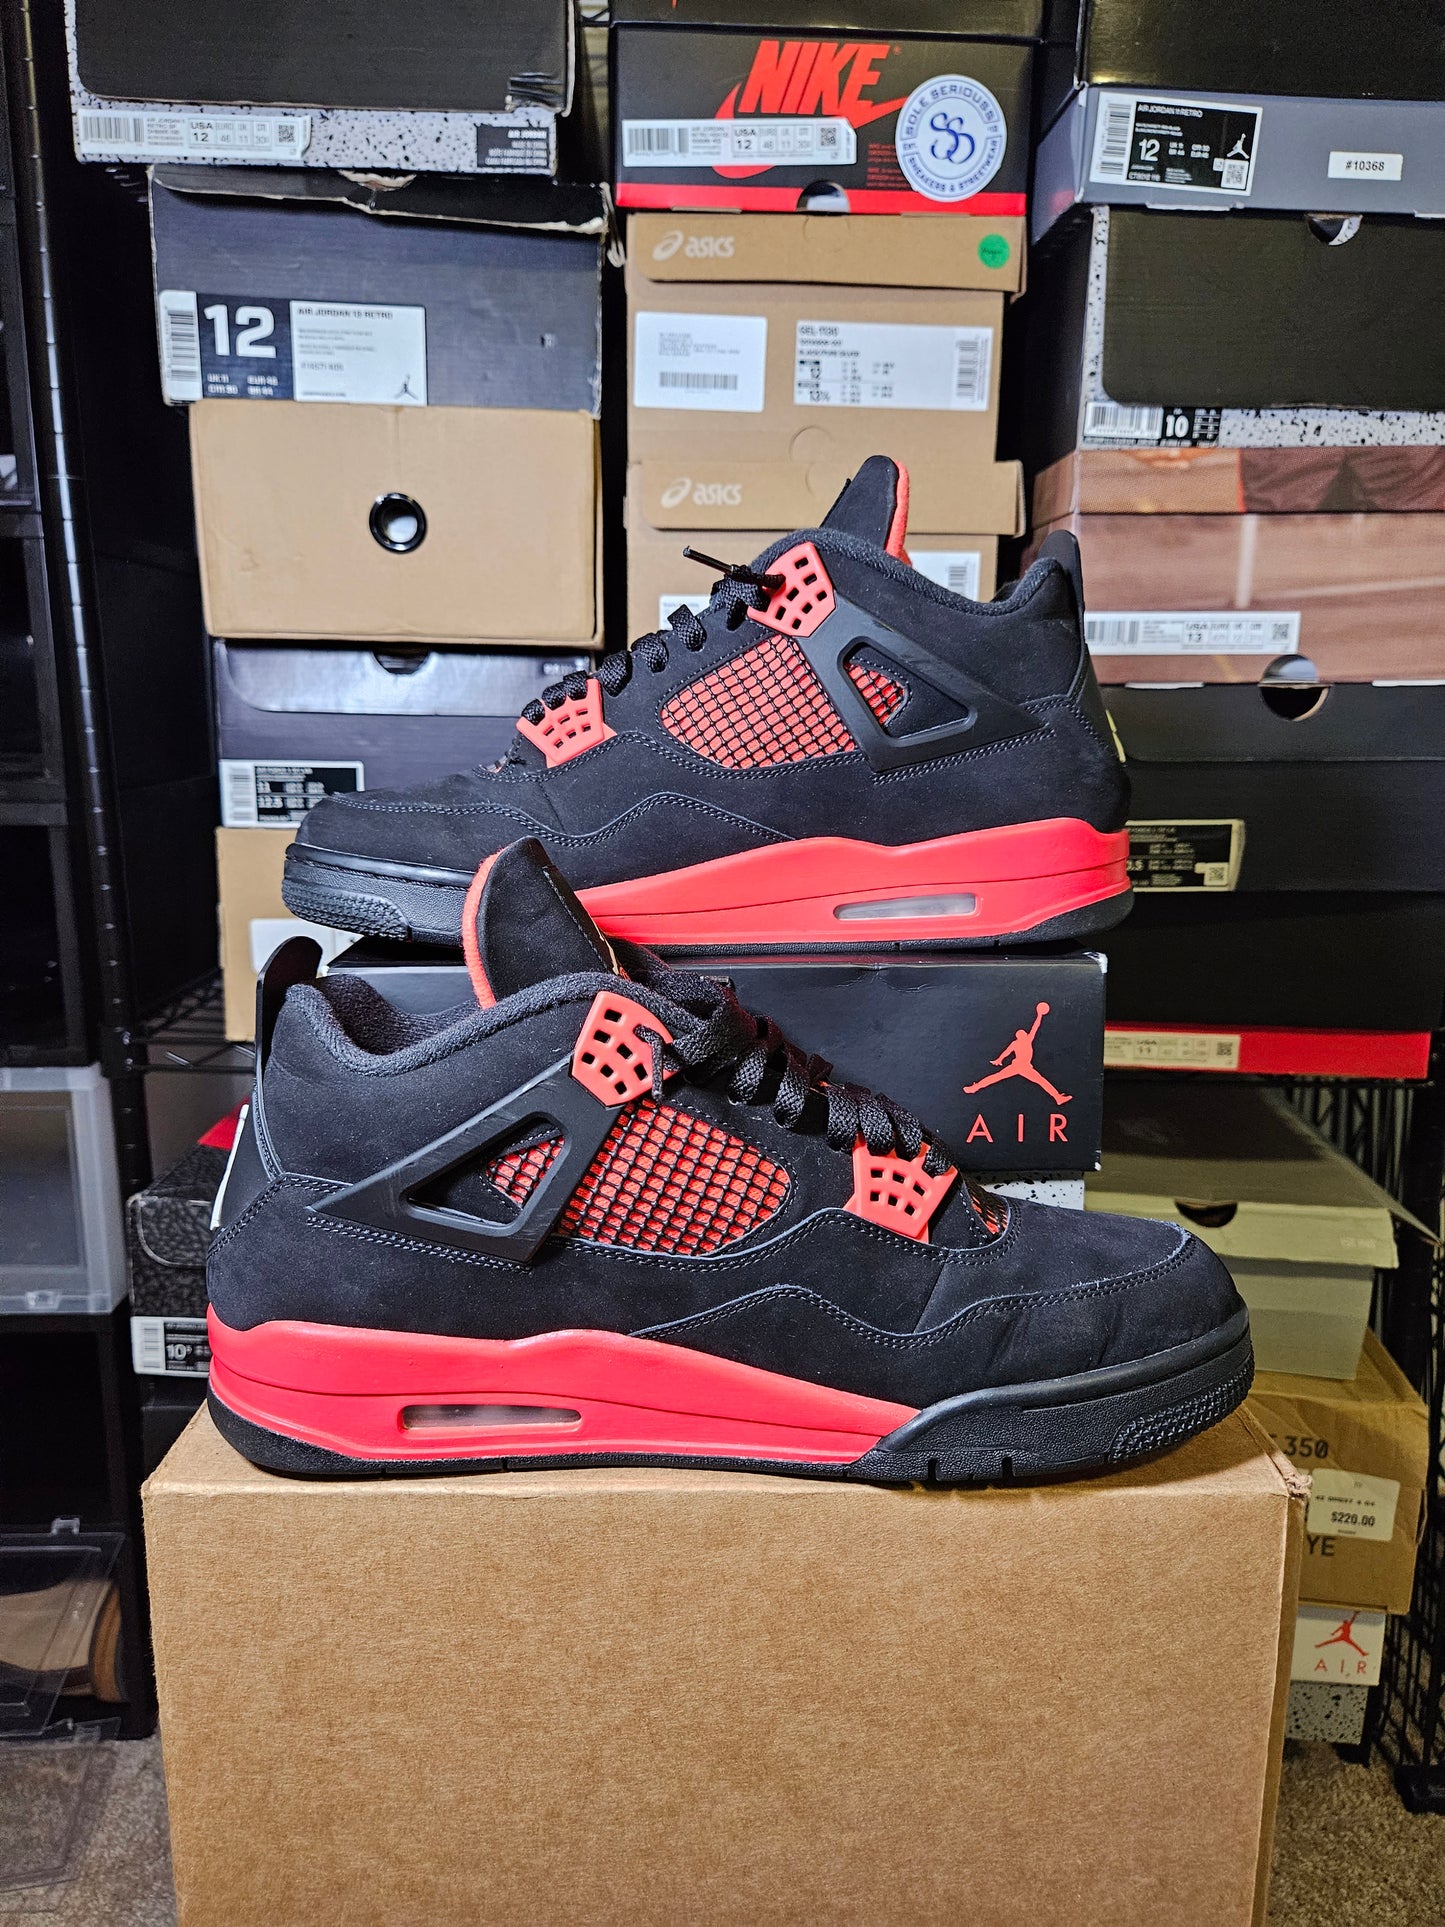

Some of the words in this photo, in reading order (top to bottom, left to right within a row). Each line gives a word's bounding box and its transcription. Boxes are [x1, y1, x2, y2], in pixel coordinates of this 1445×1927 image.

[738, 40, 890, 116] NIKE
[190, 122, 214, 130] USA
[905, 97, 929, 135] SOLE
[194, 132, 209, 142] 12
[734, 129, 756, 137] USA
[737, 140, 752, 150] 12
[1139, 138, 1160, 162] 12
[1345, 160, 1385, 172] #10368
[685, 235, 735, 258] asics
[298, 308, 313, 316] AIR
[315, 309, 351, 318] JORDAN
[364, 311, 394, 320] RETRO
[203, 304, 277, 358] 12
[1166, 414, 1190, 438] 10
[693, 482, 743, 506] asics
[966, 1113, 1069, 1144] AIR
[1284, 1435, 1329, 1459] 350
[1331, 1511, 1376, 1527] $220.00
[1314, 1658, 1368, 1675] AIR
